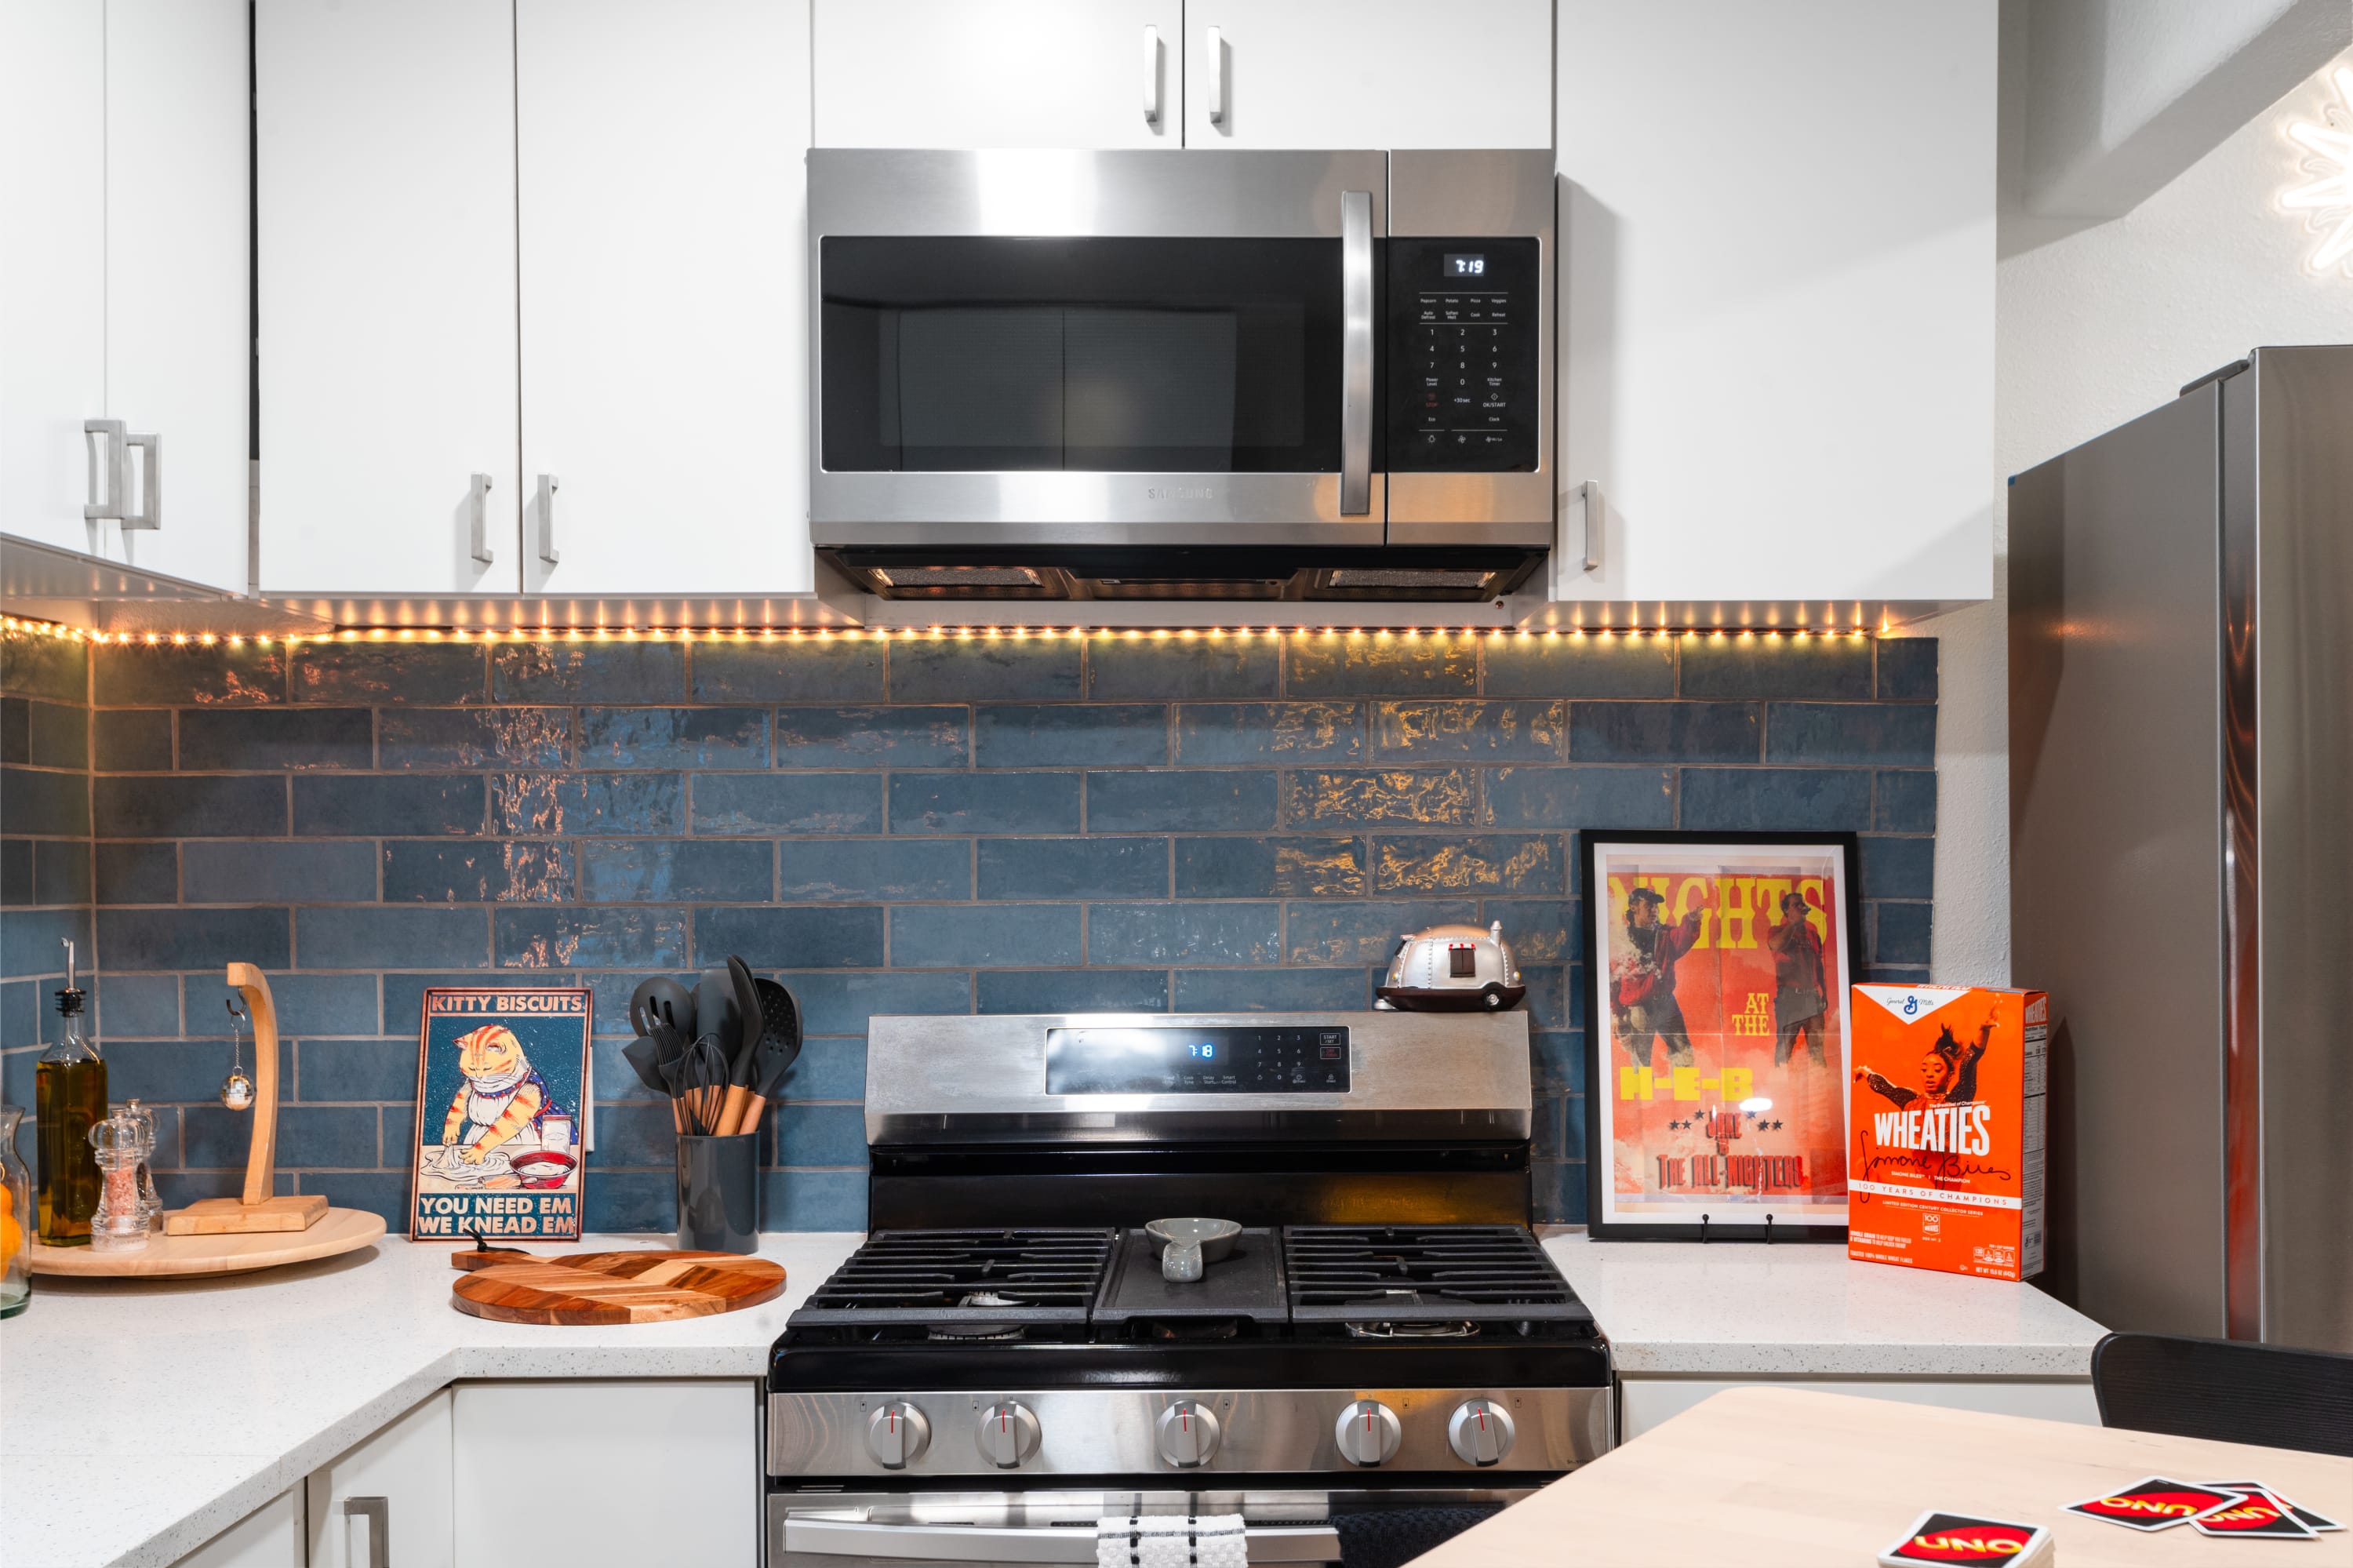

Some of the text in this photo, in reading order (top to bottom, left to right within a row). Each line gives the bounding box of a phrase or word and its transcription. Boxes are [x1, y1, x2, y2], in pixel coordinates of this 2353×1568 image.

[1455, 260, 1484, 274] 7:19
[1147, 487, 1214, 500] SAMSUNG
[432, 996, 582, 1012] KITTY BISCUITS
[1744, 992, 1769, 1014] AT
[1731, 1014, 1770, 1036] THE
[1620, 1066, 1754, 1101] H-E-B
[1874, 1104, 1991, 1157] WHEATIES
[1858, 1182, 1875, 1191] 100
[1882, 1185, 1914, 1195] YEARS
[1940, 1192, 2007, 1206] CHAMPIONS
[420, 1197, 572, 1214] YOU NEED EM
[418, 1216, 575, 1235] WE KNEAD EM
[1924, 1214, 1939, 1223] 100
[2098, 1497, 2198, 1517] UNO
[1913, 1536, 2024, 1554] UNO
